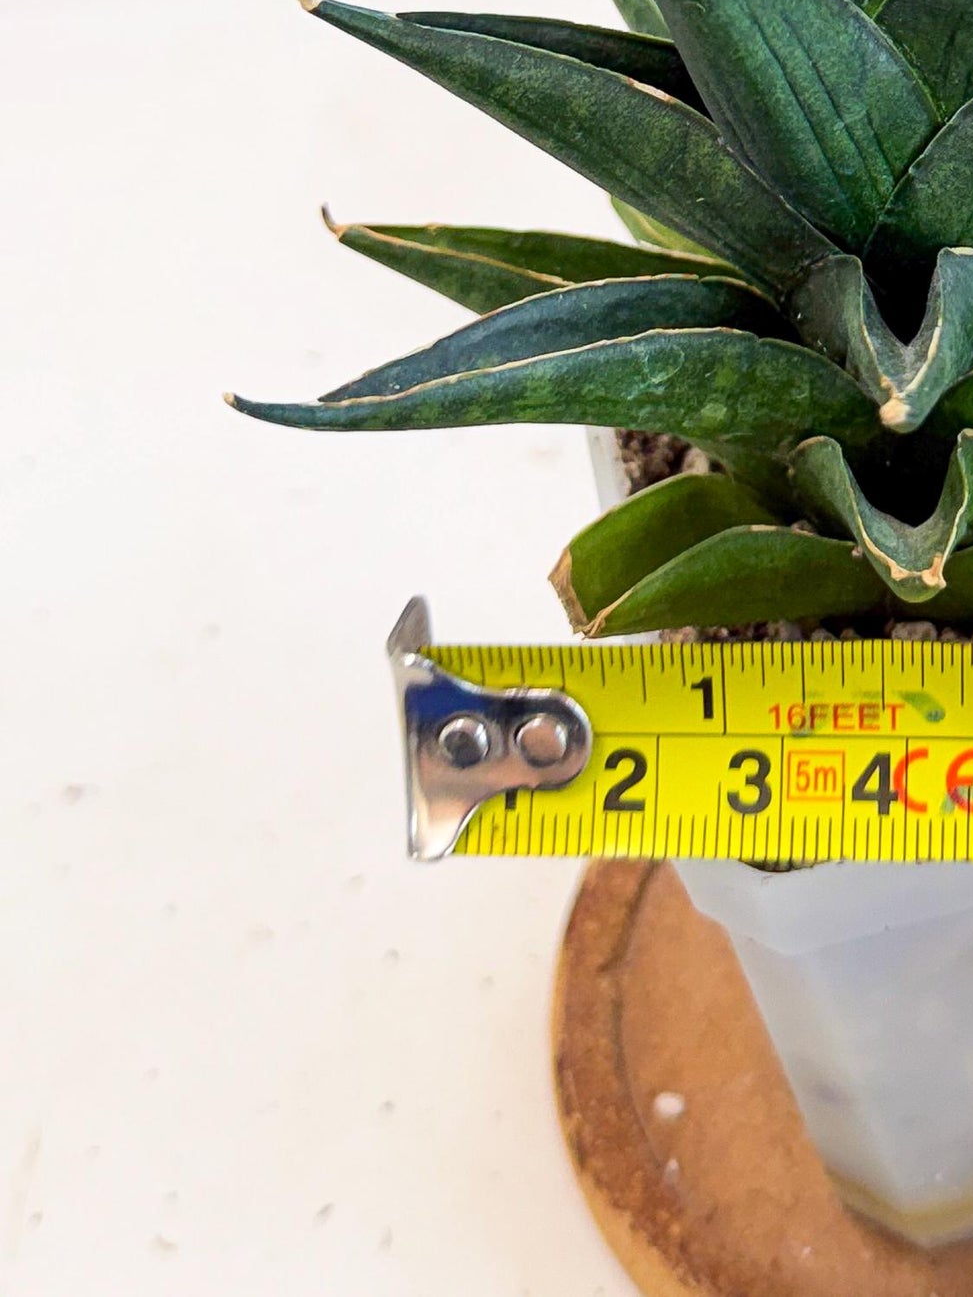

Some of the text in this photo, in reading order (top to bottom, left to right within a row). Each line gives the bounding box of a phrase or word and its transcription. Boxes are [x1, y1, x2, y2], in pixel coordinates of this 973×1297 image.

[691, 677, 714, 720] 1
[603, 748, 647, 811] 2
[727, 750, 772, 814] 3
[795, 759, 837, 792] 5m
[852, 752, 899, 815] 4
